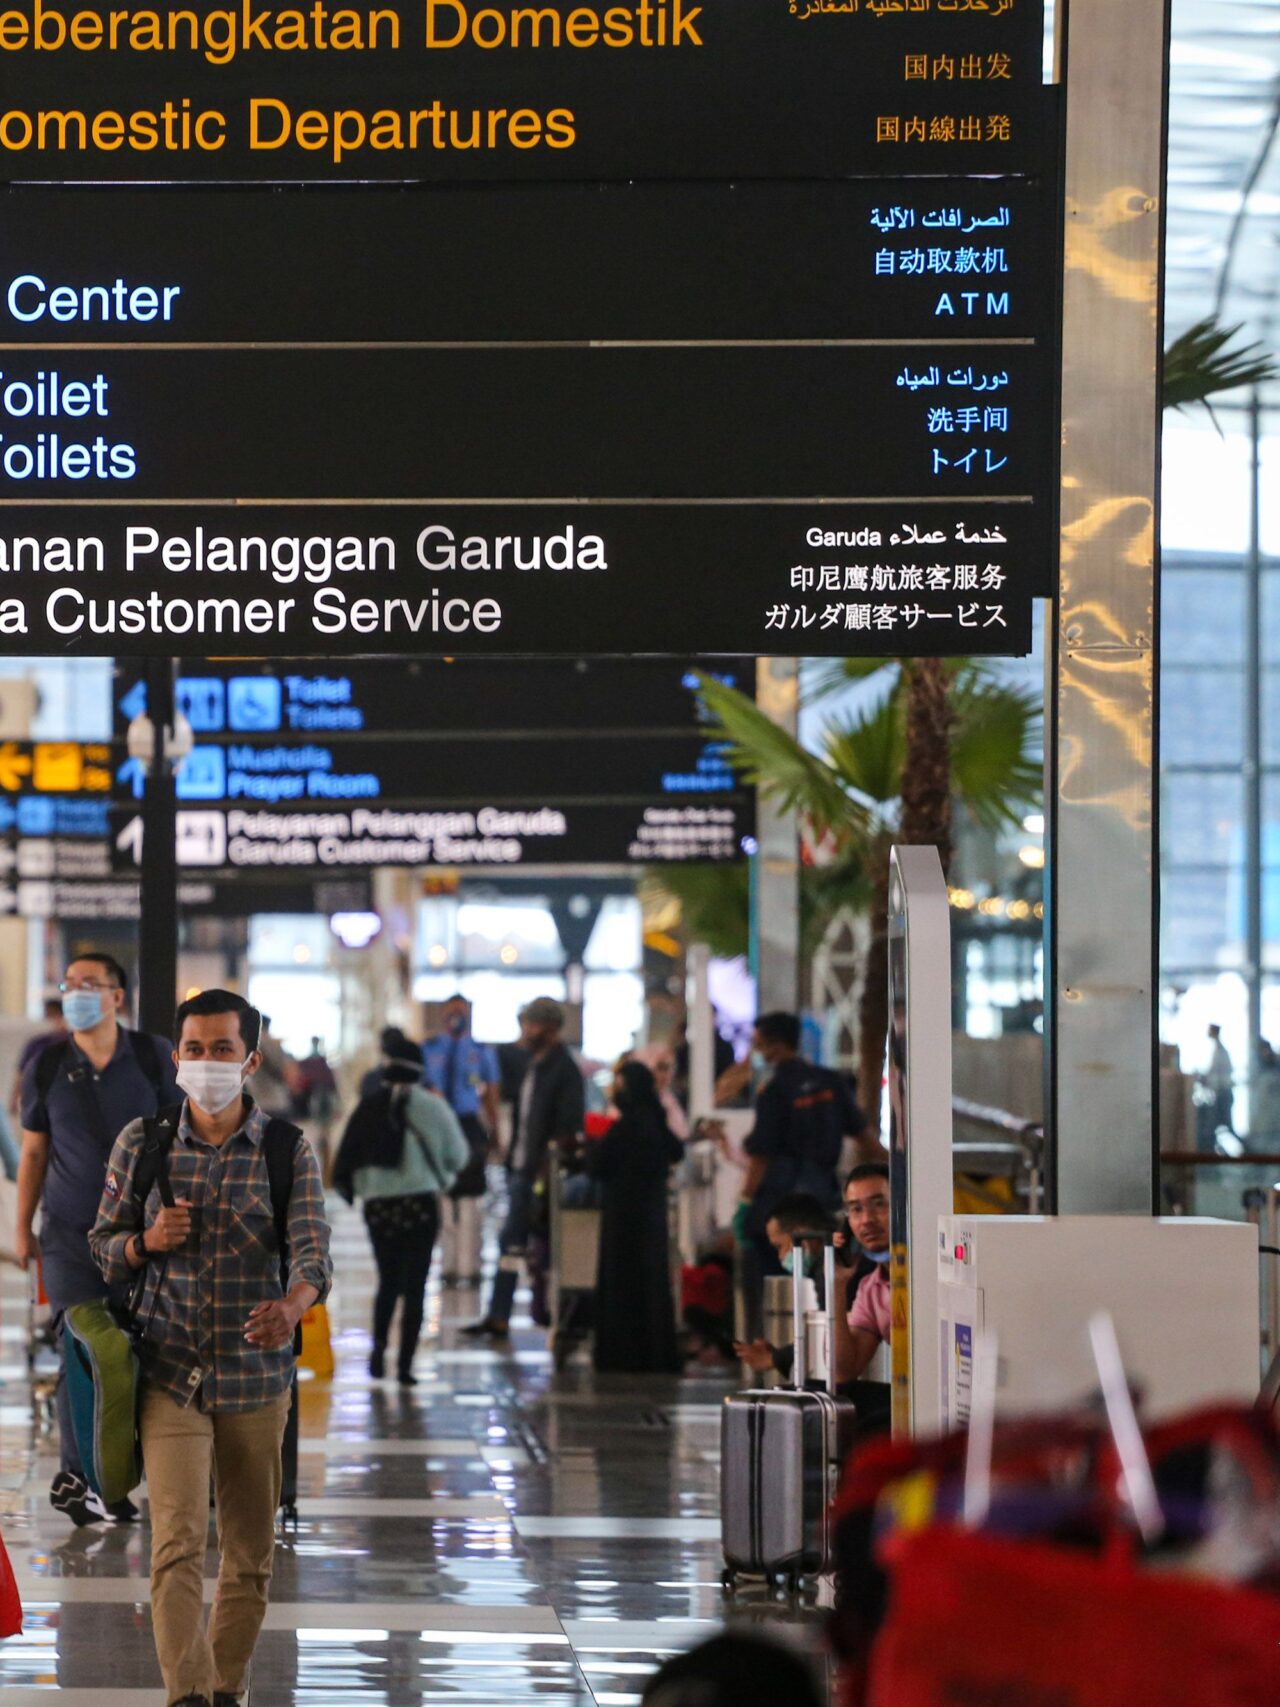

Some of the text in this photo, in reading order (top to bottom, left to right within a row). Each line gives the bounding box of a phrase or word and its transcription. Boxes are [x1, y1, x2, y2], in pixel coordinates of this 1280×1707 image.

[426, 0, 703, 48] Domestik
[905, 54, 1010, 80] 国内出发
[250, 98, 575, 163] Departures
[877, 116, 1009, 142] 国内線出発
[876, 247, 1008, 275] 自动取款机
[8, 275, 181, 322] Center
[896, 366, 1008, 391] دورات المياه
[927, 406, 1008, 433] 洗手间
[933, 448, 1007, 474] トイレ
[806, 522, 1007, 546] خدمة عملاء Garuda
[126, 527, 395, 583] Pelanggan
[417, 525, 607, 570] Garuda
[791, 563, 1006, 591] 印尼鹰航旅客服务
[46, 588, 295, 634] Customer
[312, 587, 501, 633] Service
[765, 602, 1006, 630] ガルダ顧客サービス
[477, 806, 566, 836] Garuda
